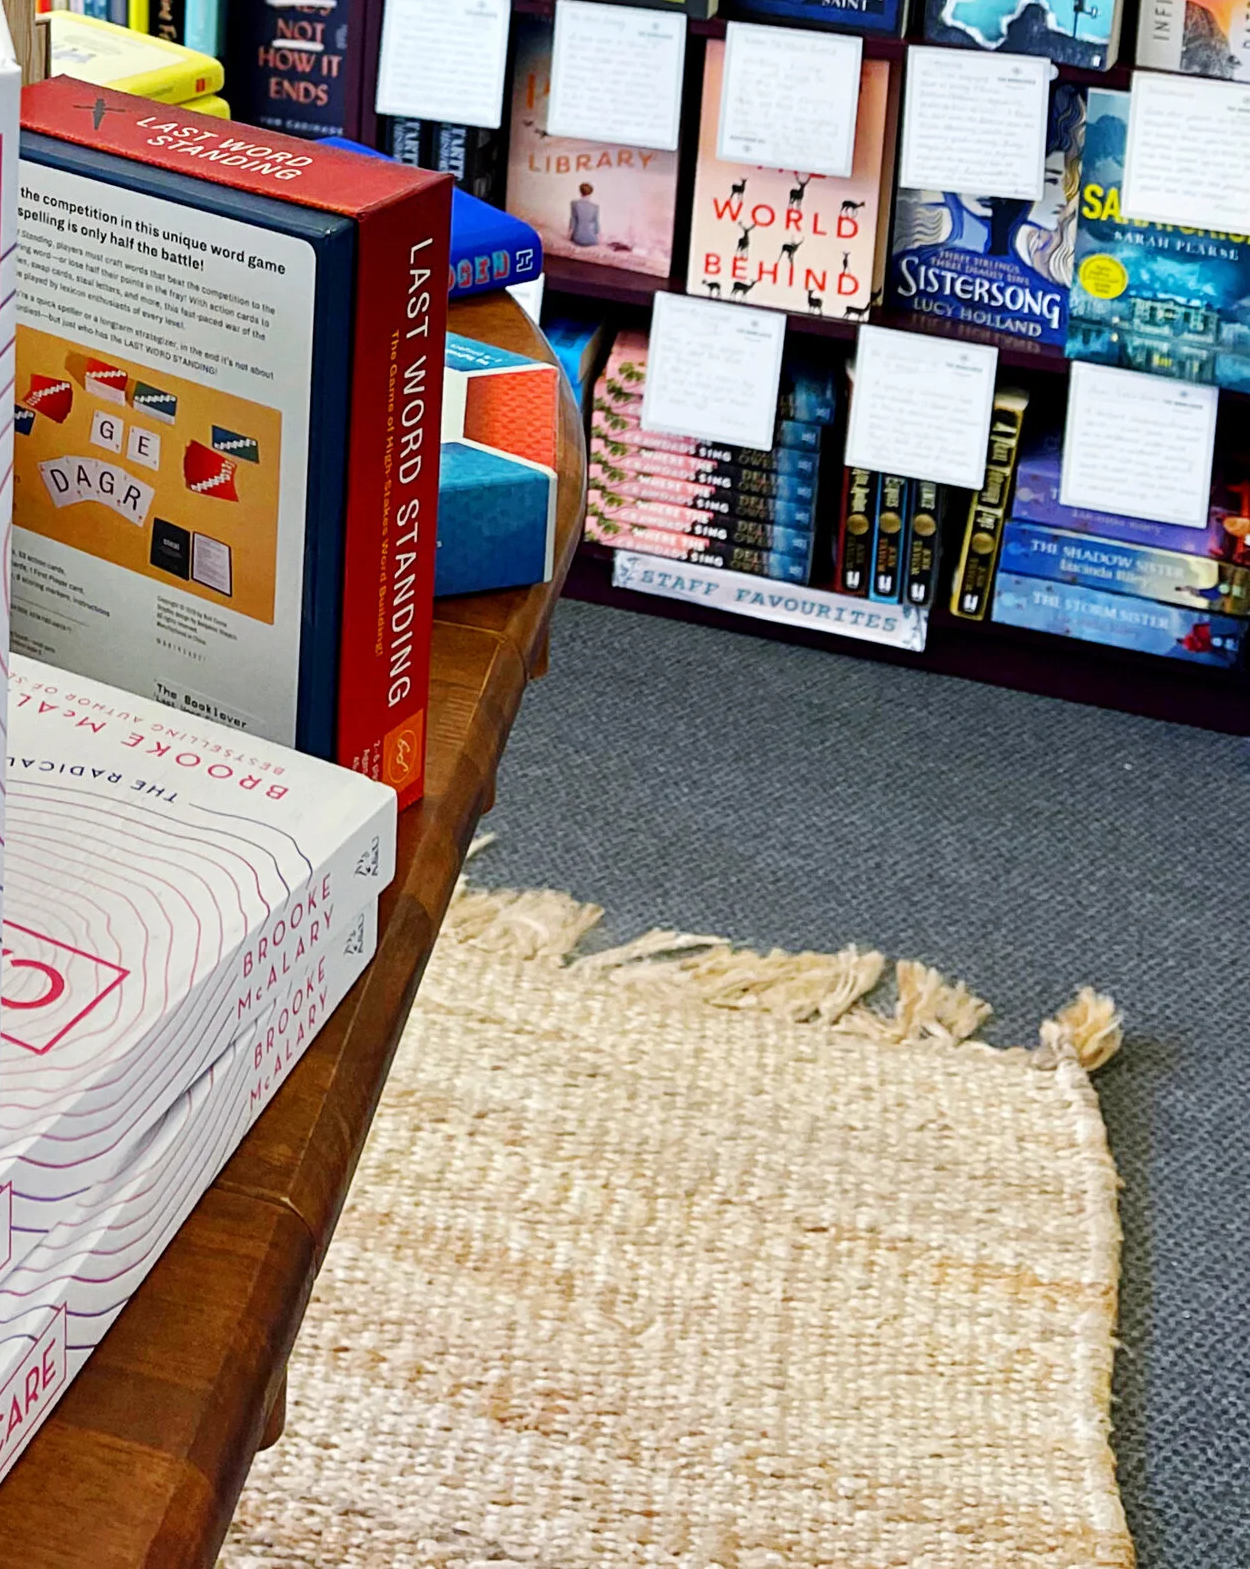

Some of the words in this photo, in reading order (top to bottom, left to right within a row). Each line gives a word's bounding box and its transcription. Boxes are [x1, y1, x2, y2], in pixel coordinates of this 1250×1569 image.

[277, 17, 326, 43] NOT
[258, 46, 317, 73] HOW
[321, 54, 343, 78] IT
[269, 77, 329, 106] ENDS
[136, 116, 219, 142] LAST
[218, 138, 313, 167] WORD
[147, 135, 302, 180] STANDING
[527, 149, 654, 175] LIBRARY
[17, 206, 65, 232] spelling
[67, 220, 78, 234] is
[80, 224, 108, 244] only
[110, 232, 135, 251] half
[137, 240, 158, 258] the
[161, 248, 205, 271] battle!
[20, 186, 40, 202] the
[42, 194, 118, 226] competition
[120, 215, 132, 230] in
[135, 220, 160, 238] this
[162, 230, 208, 254] unique
[210, 243, 245, 262] word
[247, 253, 287, 276] game
[712, 197, 859, 239] WORLD
[1114, 231, 1169, 249] SARAH
[1175, 239, 1239, 261] PEARSE
[405, 237, 434, 339] LAST
[703, 252, 859, 297] BEHIND
[897, 256, 1061, 329] SISTERSONG
[914, 297, 956, 316] LUCY
[960, 307, 1042, 337] HOLLAND
[398, 354, 427, 486] WORD
[387, 496, 419, 709] STANDING
[637, 568, 720, 596] STAFF
[735, 586, 898, 632] FAVOURITES
[8, 756, 124, 783] RADICAL
[130, 779, 179, 804] THE
[242, 872, 334, 980] BROOKE
[236, 905, 336, 1021] McALARY
[252, 955, 328, 1073] BROOKE
[249, 988, 329, 1113] McALARY
